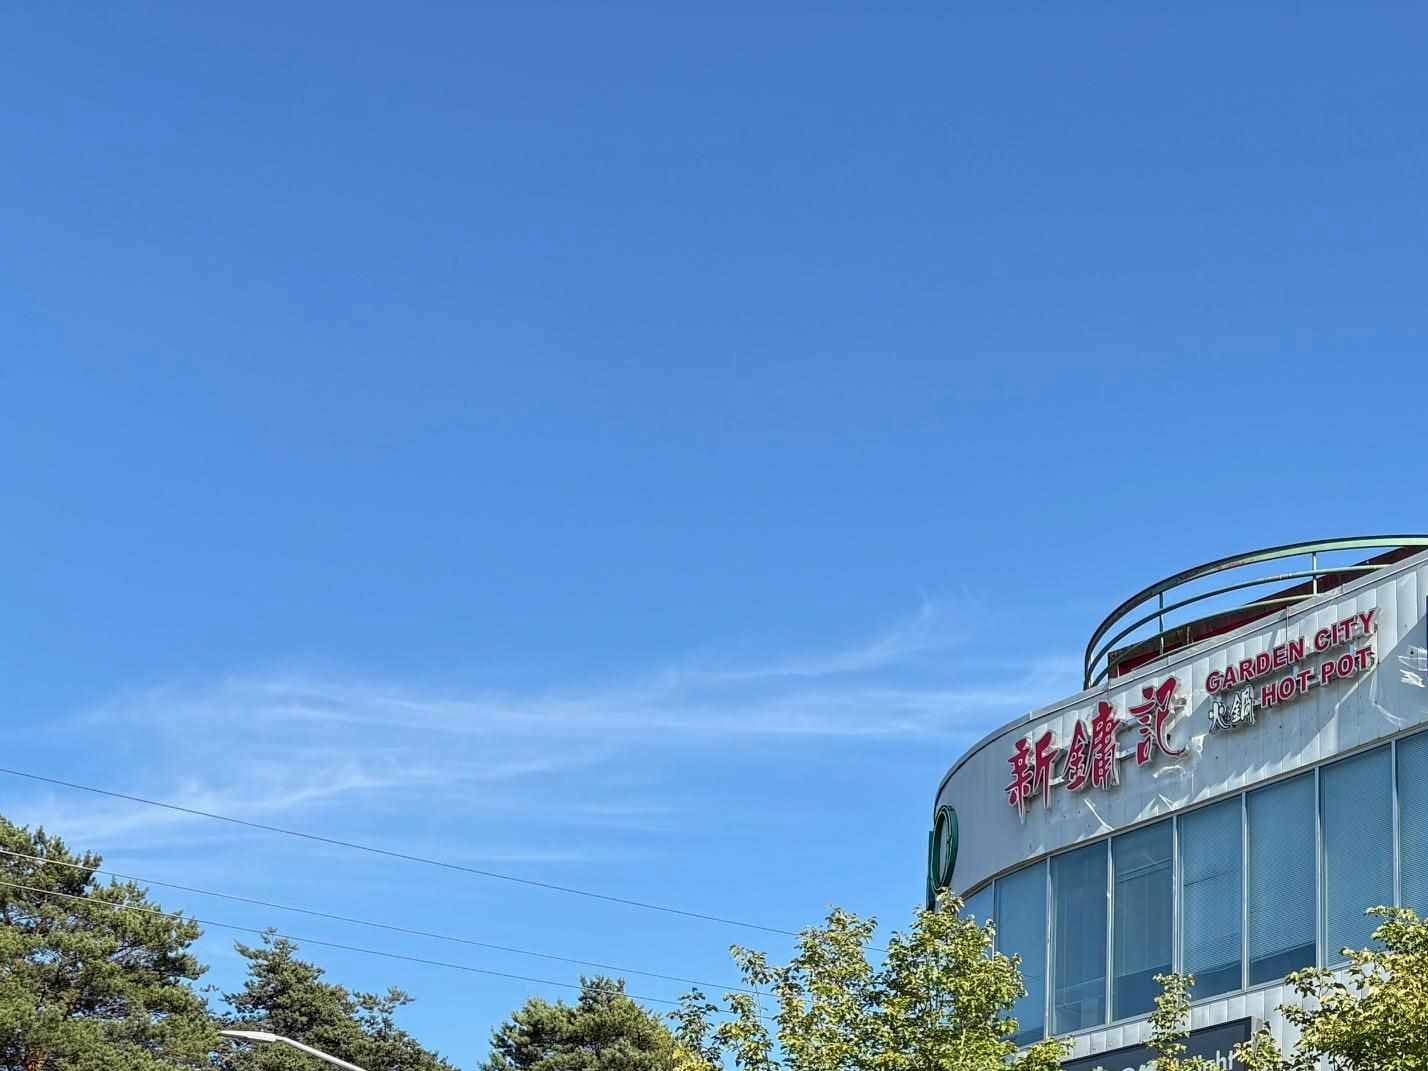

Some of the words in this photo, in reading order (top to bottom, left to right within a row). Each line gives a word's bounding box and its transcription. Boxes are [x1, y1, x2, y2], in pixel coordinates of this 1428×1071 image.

[1204, 636, 1306, 695] GARDEN
[1313, 608, 1381, 654] CITY
[1208, 691, 1256, 735] 火鍋
[1259, 669, 1313, 710] HOT
[1319, 646, 1376, 684] POT
